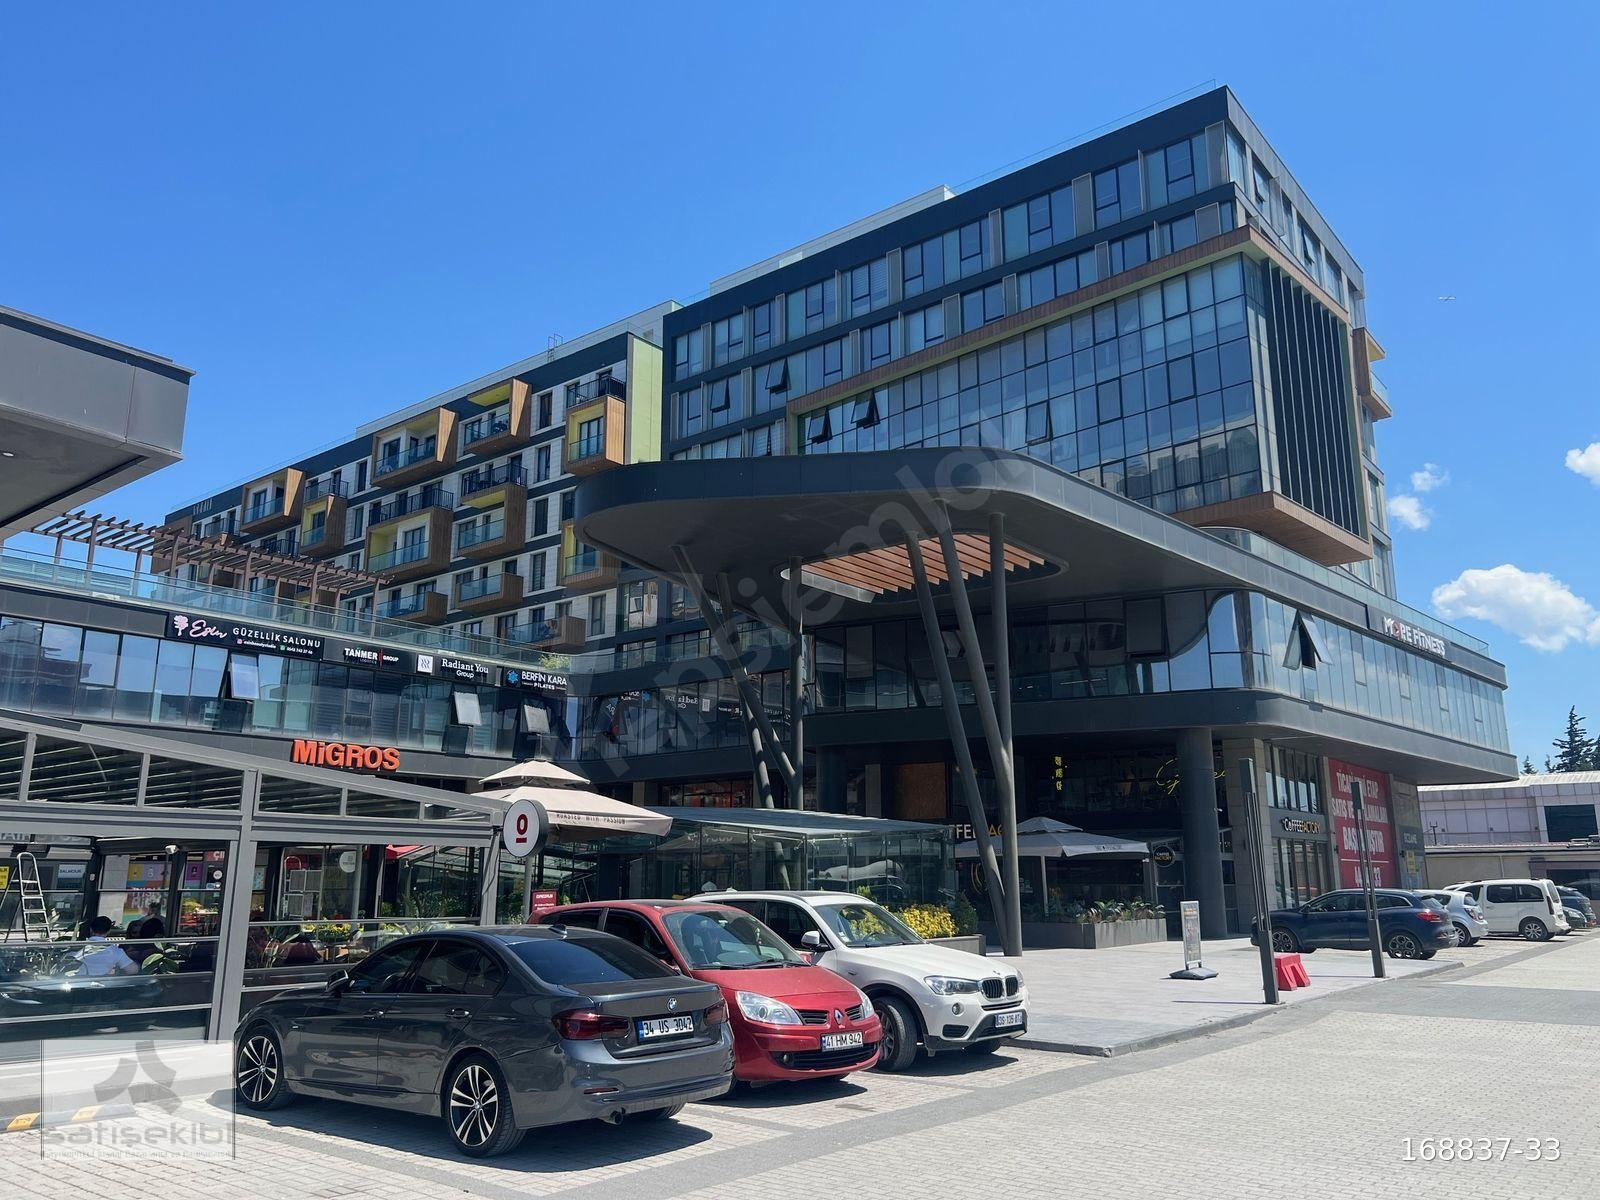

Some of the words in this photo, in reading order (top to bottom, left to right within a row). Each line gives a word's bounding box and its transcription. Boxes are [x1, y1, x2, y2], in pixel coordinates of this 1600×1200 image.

[232, 627, 281, 643] GÜZELLİK
[282, 635, 321, 648] SALONU
[344, 648, 378, 661] TANMER
[441, 659, 474, 672] Radiant
[475, 664, 490, 674] You
[456, 670, 475, 679] Group
[547, 674, 568, 686] KARA
[643, 1022, 655, 1036] 34
[659, 1019, 670, 1034] US
[674, 1017, 693, 1032] 3042
[826, 1036, 834, 1047] 41
[835, 1034, 848, 1047] HM
[849, 1032, 862, 1045] 942
